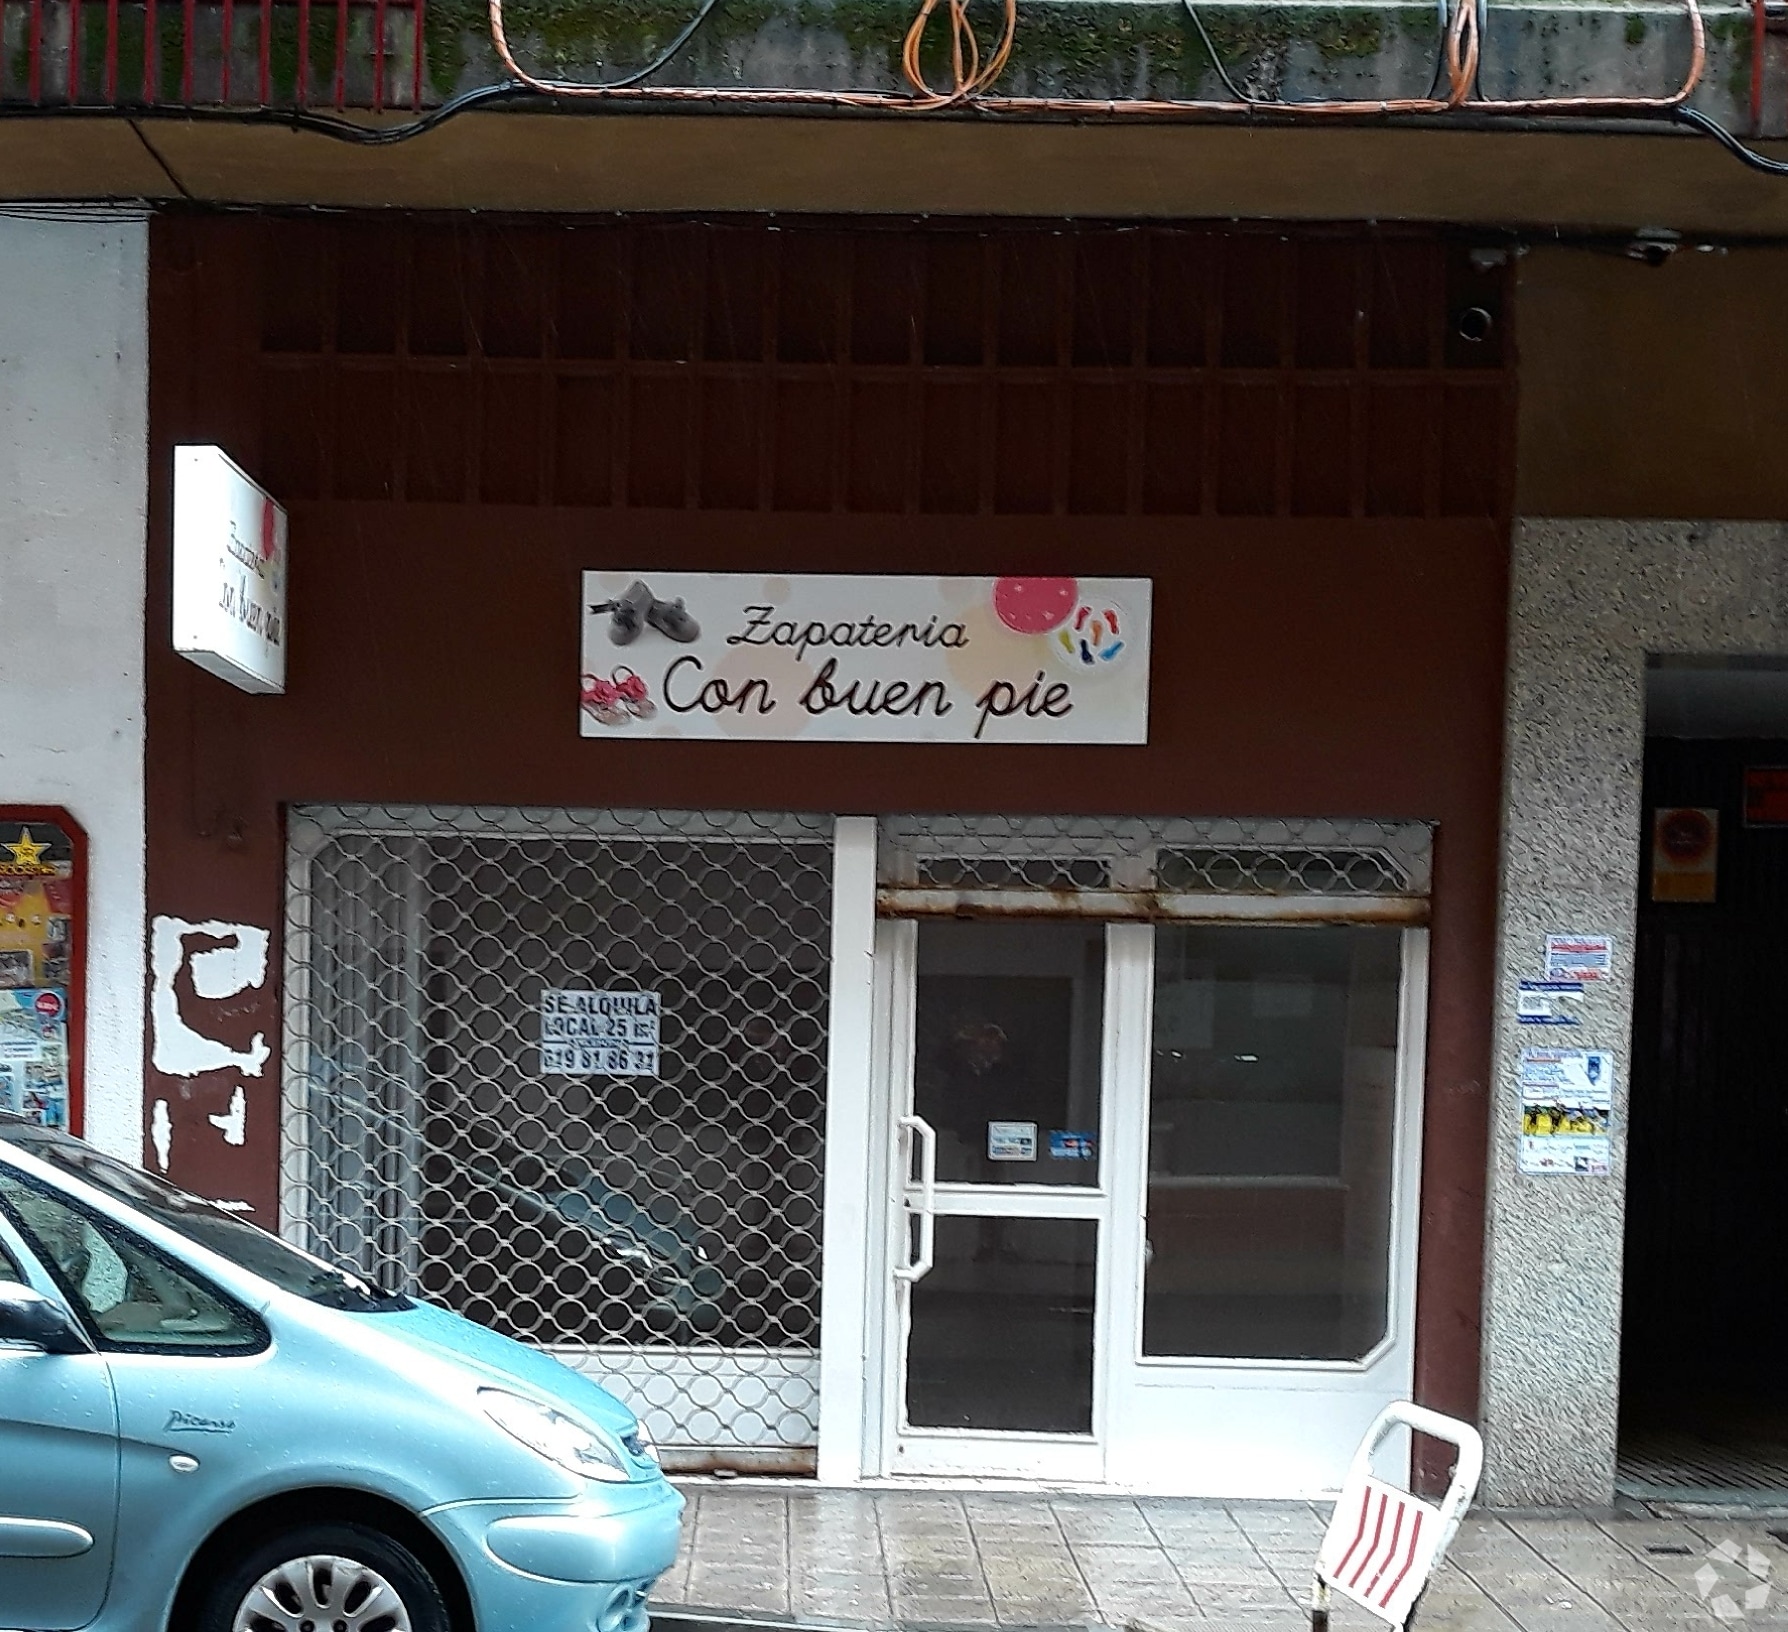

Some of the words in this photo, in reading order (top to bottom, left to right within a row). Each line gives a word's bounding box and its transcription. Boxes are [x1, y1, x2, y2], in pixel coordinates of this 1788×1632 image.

[663, 655, 776, 715] Con
[800, 657, 953, 717] buen
[973, 671, 1075, 739] pie
[544, 996, 568, 1014] SE
[577, 996, 657, 1017] ALQUILA
[544, 1017, 600, 1036] LOCAL
[606, 1018, 627, 1037] 25
